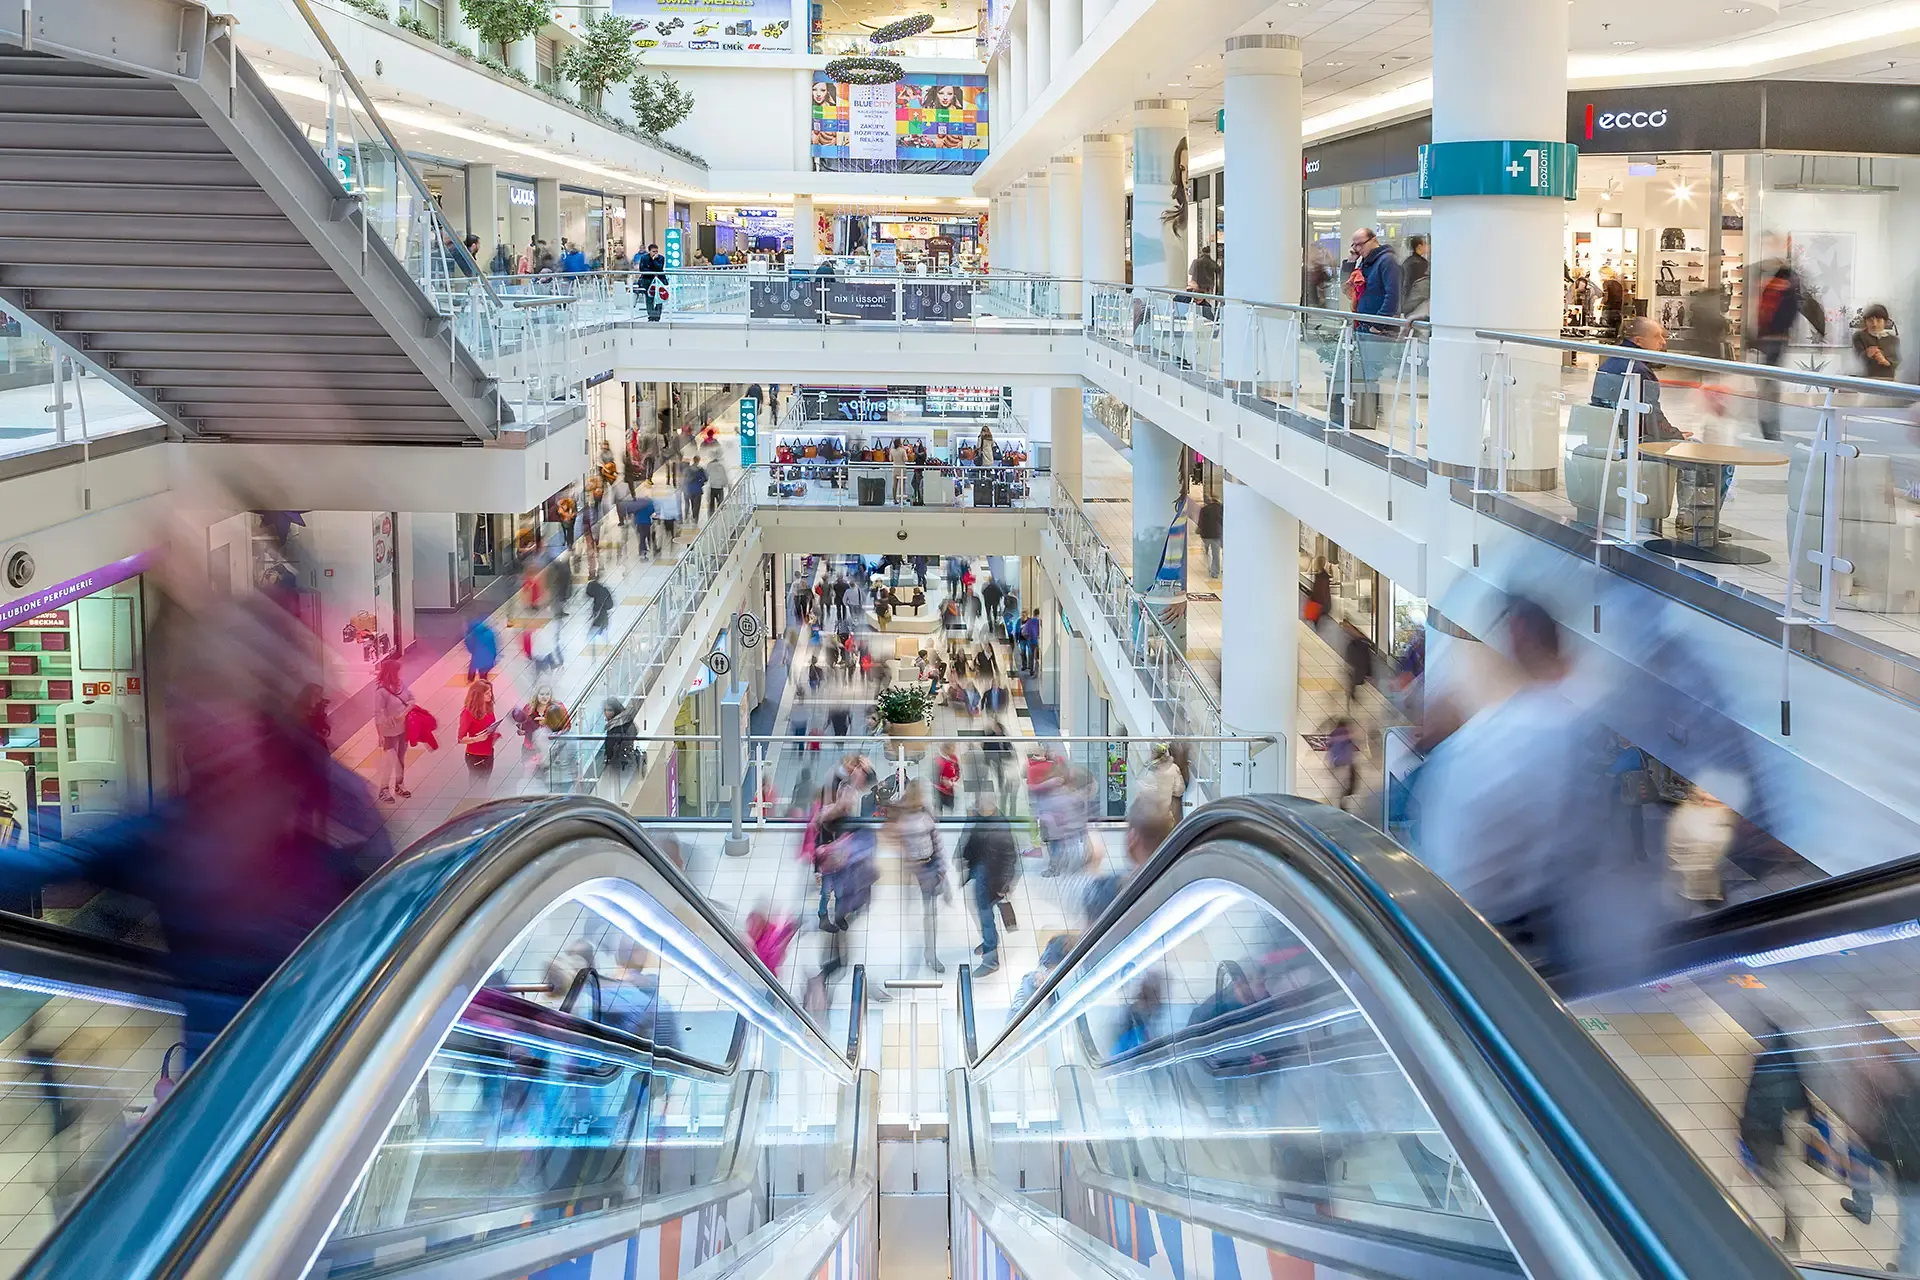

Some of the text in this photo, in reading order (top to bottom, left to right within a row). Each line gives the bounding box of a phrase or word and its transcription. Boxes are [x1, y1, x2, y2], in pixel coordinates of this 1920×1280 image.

[690, 41, 718, 50] bruder
[1598, 108, 1668, 130] ecco
[1540, 149, 1549, 188] poziom
[0, 578, 93, 621] LUBIONE PERFUMERIE
